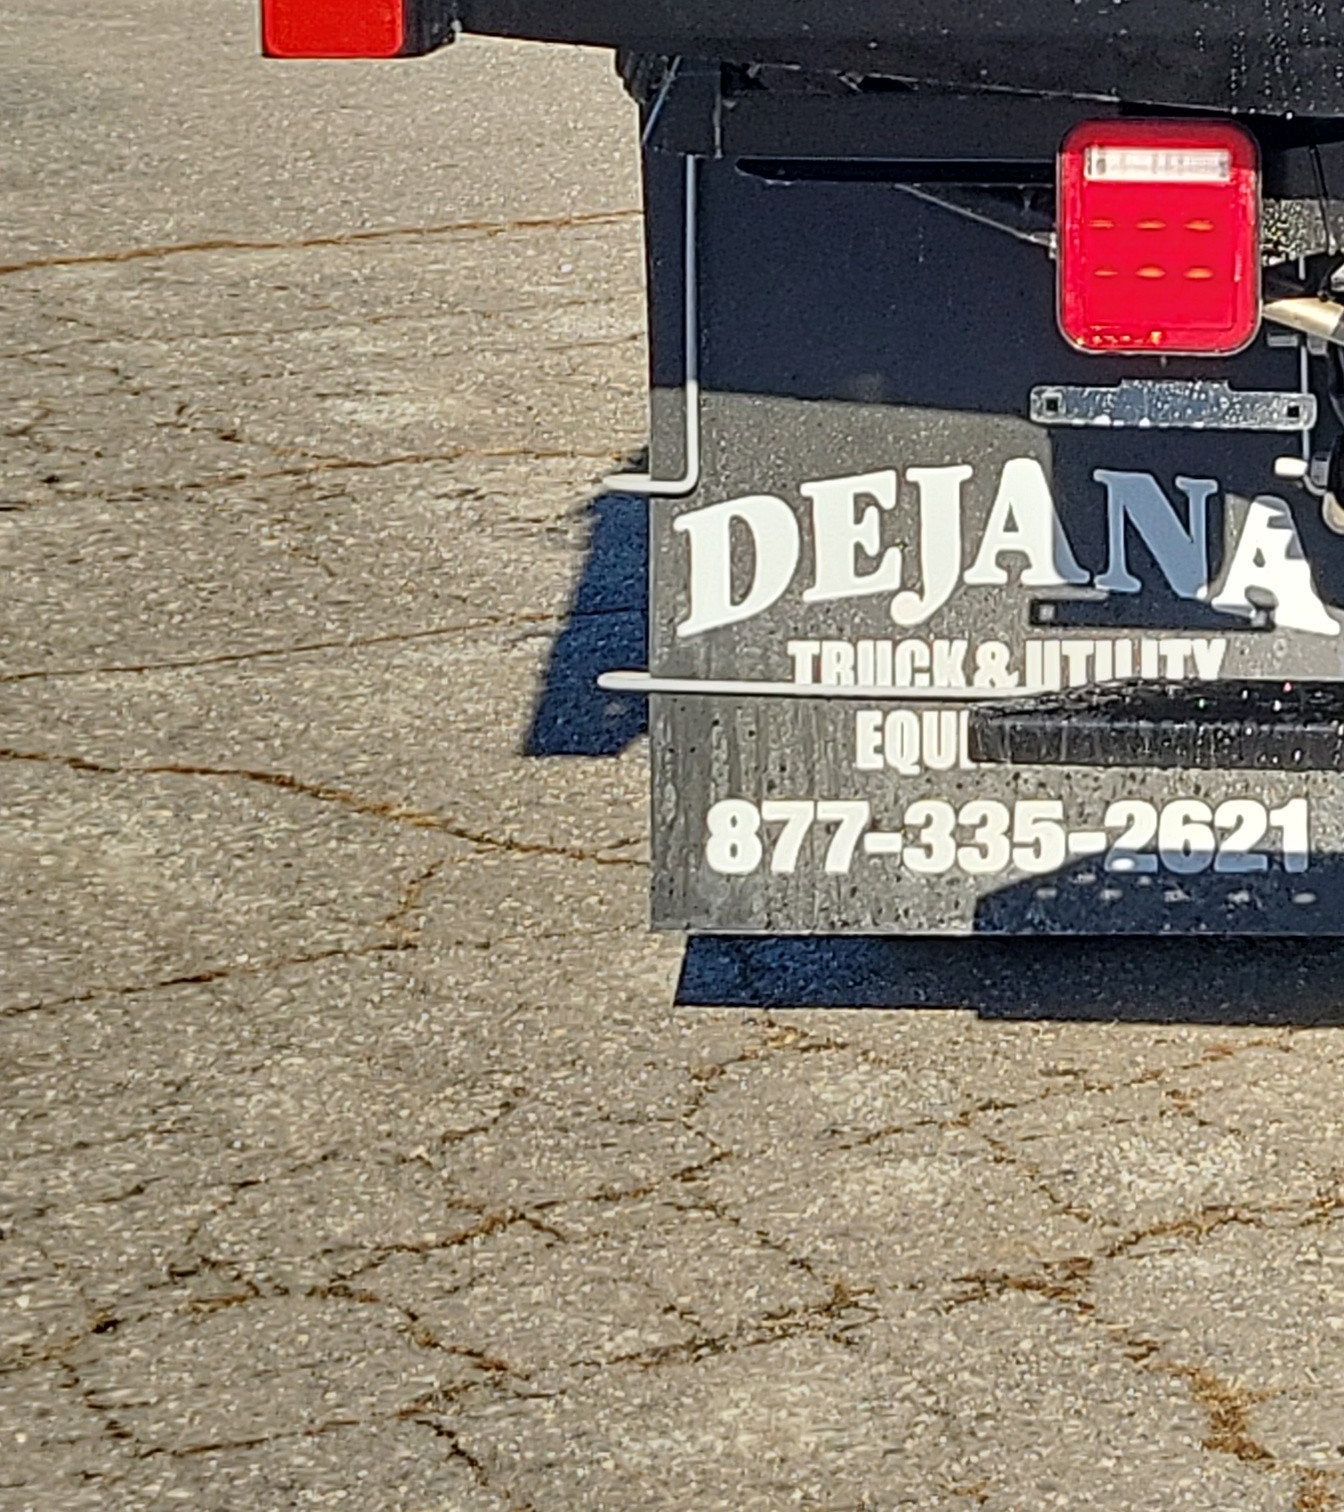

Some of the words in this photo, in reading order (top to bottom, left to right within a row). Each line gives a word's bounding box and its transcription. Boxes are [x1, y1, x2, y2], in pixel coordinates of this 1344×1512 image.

[672, 457, 1342, 637] DEJANA
[787, 639, 969, 688] TRUCK
[974, 639, 1019, 688] &
[1025, 638, 1226, 689] UTILITY
[705, 797, 1310, 875] 877-335-2621
